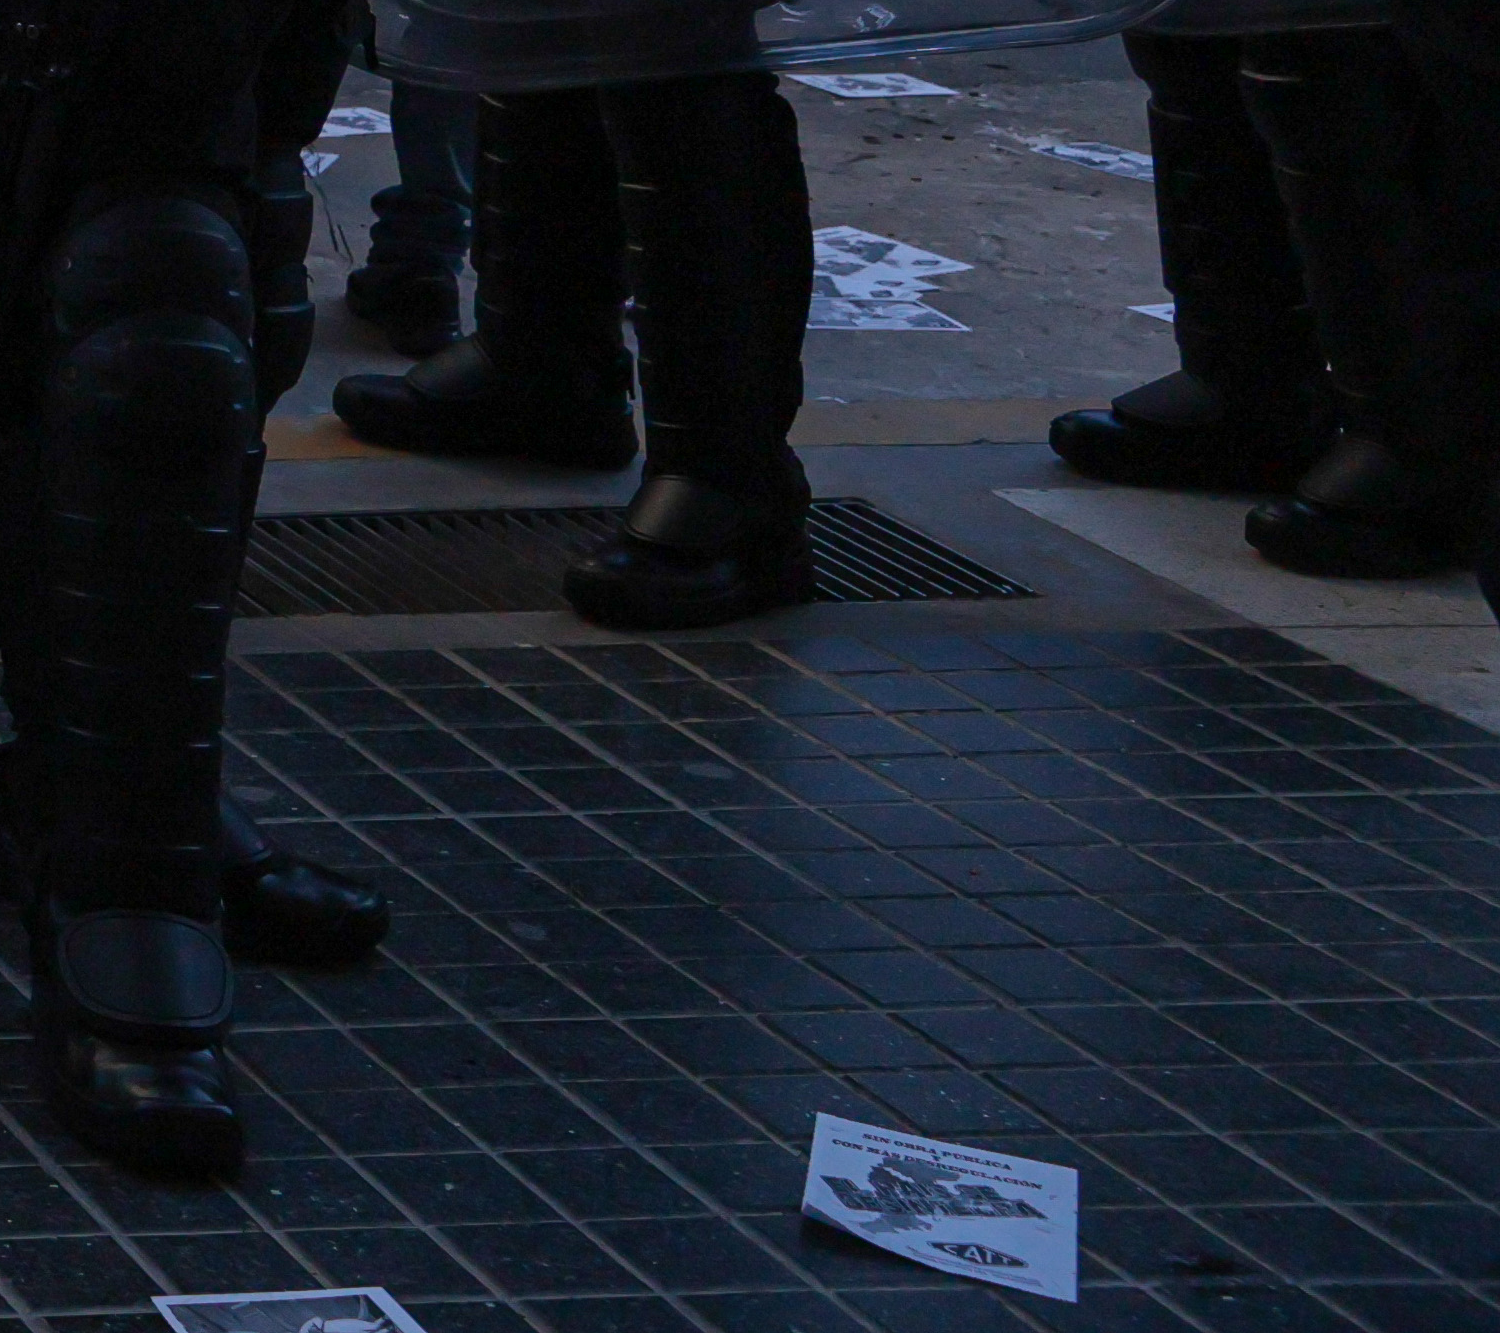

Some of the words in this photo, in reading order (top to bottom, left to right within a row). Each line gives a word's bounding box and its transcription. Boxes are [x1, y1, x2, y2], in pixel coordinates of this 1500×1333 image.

[832, 1139, 865, 1152] CON
[863, 1133, 890, 1145] SIN
[894, 1140, 937, 1155] OBRA
[942, 1245, 1011, 1266] CATT
